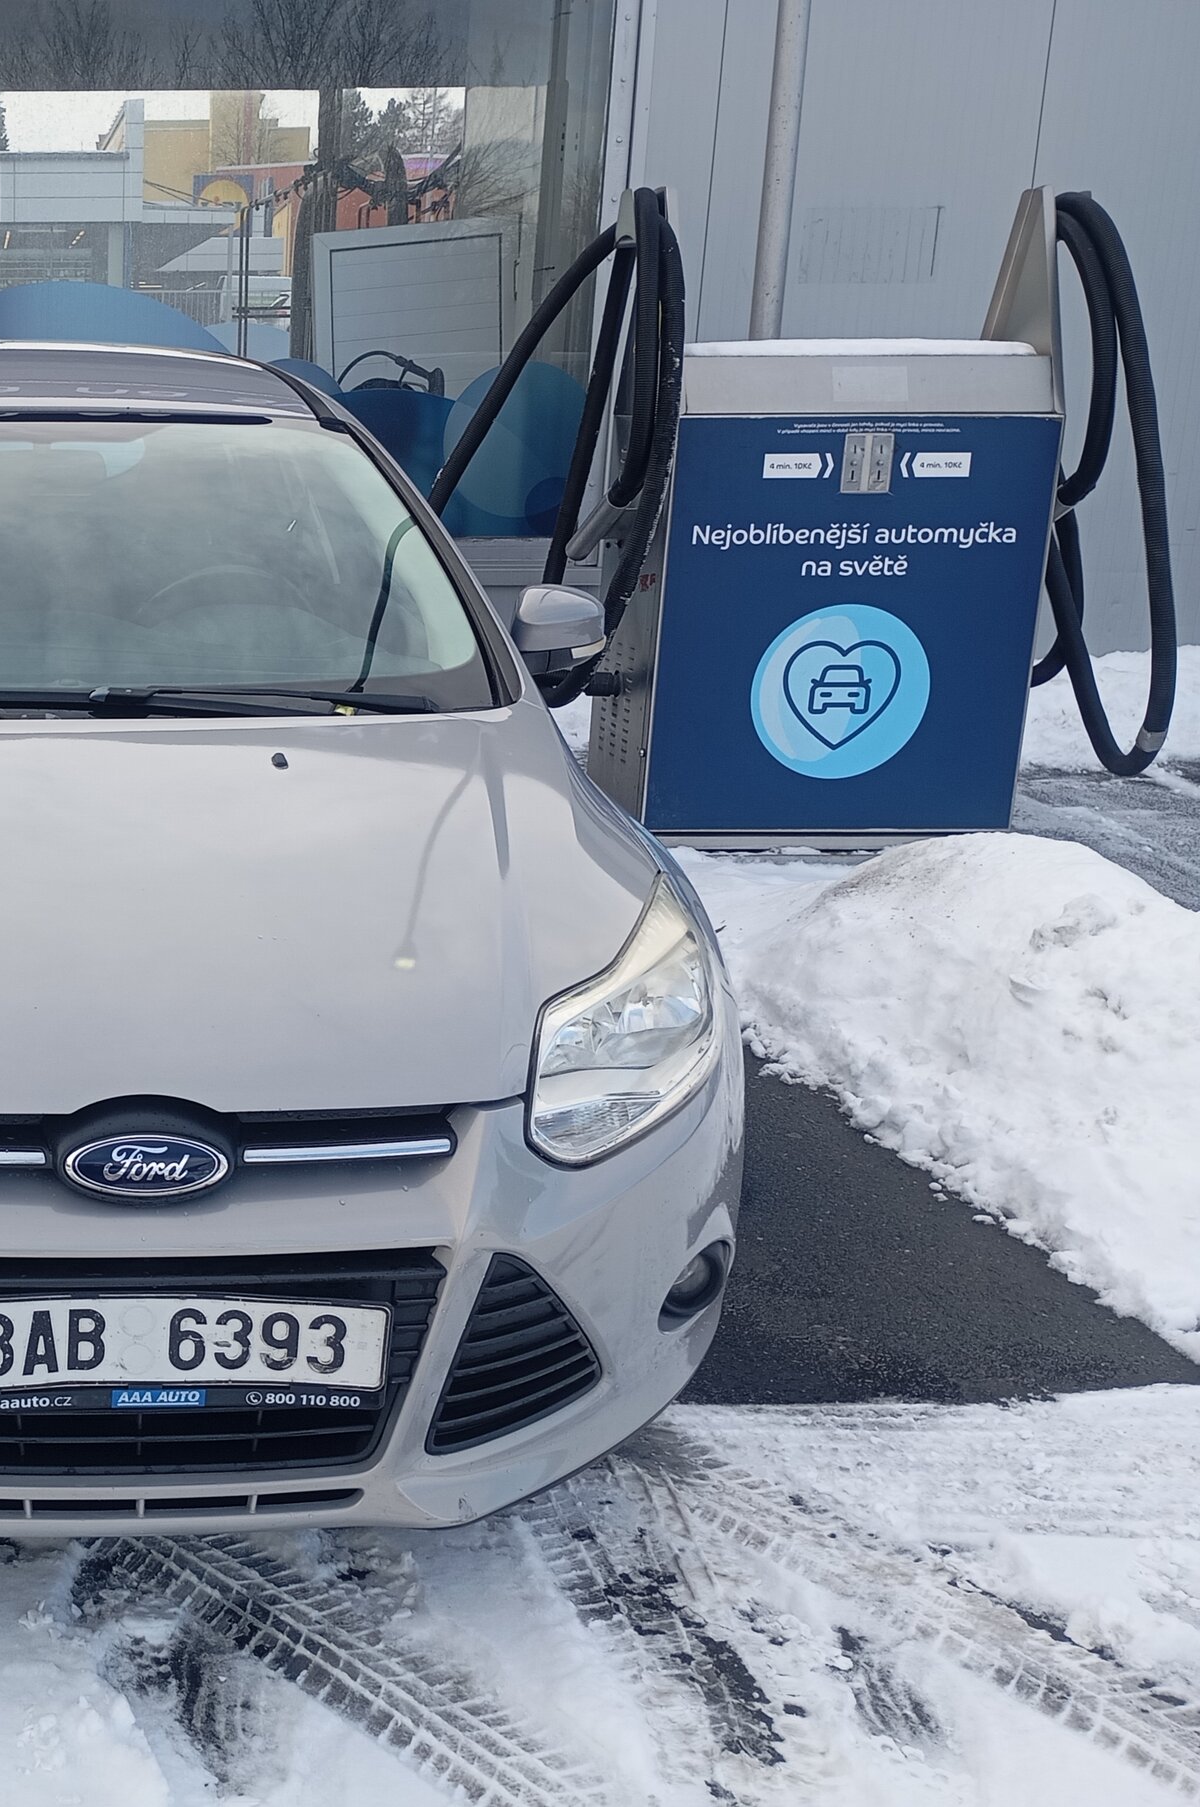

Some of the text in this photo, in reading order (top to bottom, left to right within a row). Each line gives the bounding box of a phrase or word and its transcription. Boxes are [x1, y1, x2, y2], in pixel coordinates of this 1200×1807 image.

[775, 462, 792, 470] min.
[793, 461, 813, 470] 10Kč
[926, 461, 942, 469] min.
[944, 460, 963, 469] 10Kč
[692, 521, 1018, 550] Nejoblíbenější automyčka
[801, 554, 909, 576] na světě
[103, 1144, 190, 1181] Ford
[166, 1306, 349, 1377] 6393
[117, 1390, 201, 1404] AAA AUTO
[264, 1392, 362, 1408] 800 110 800
